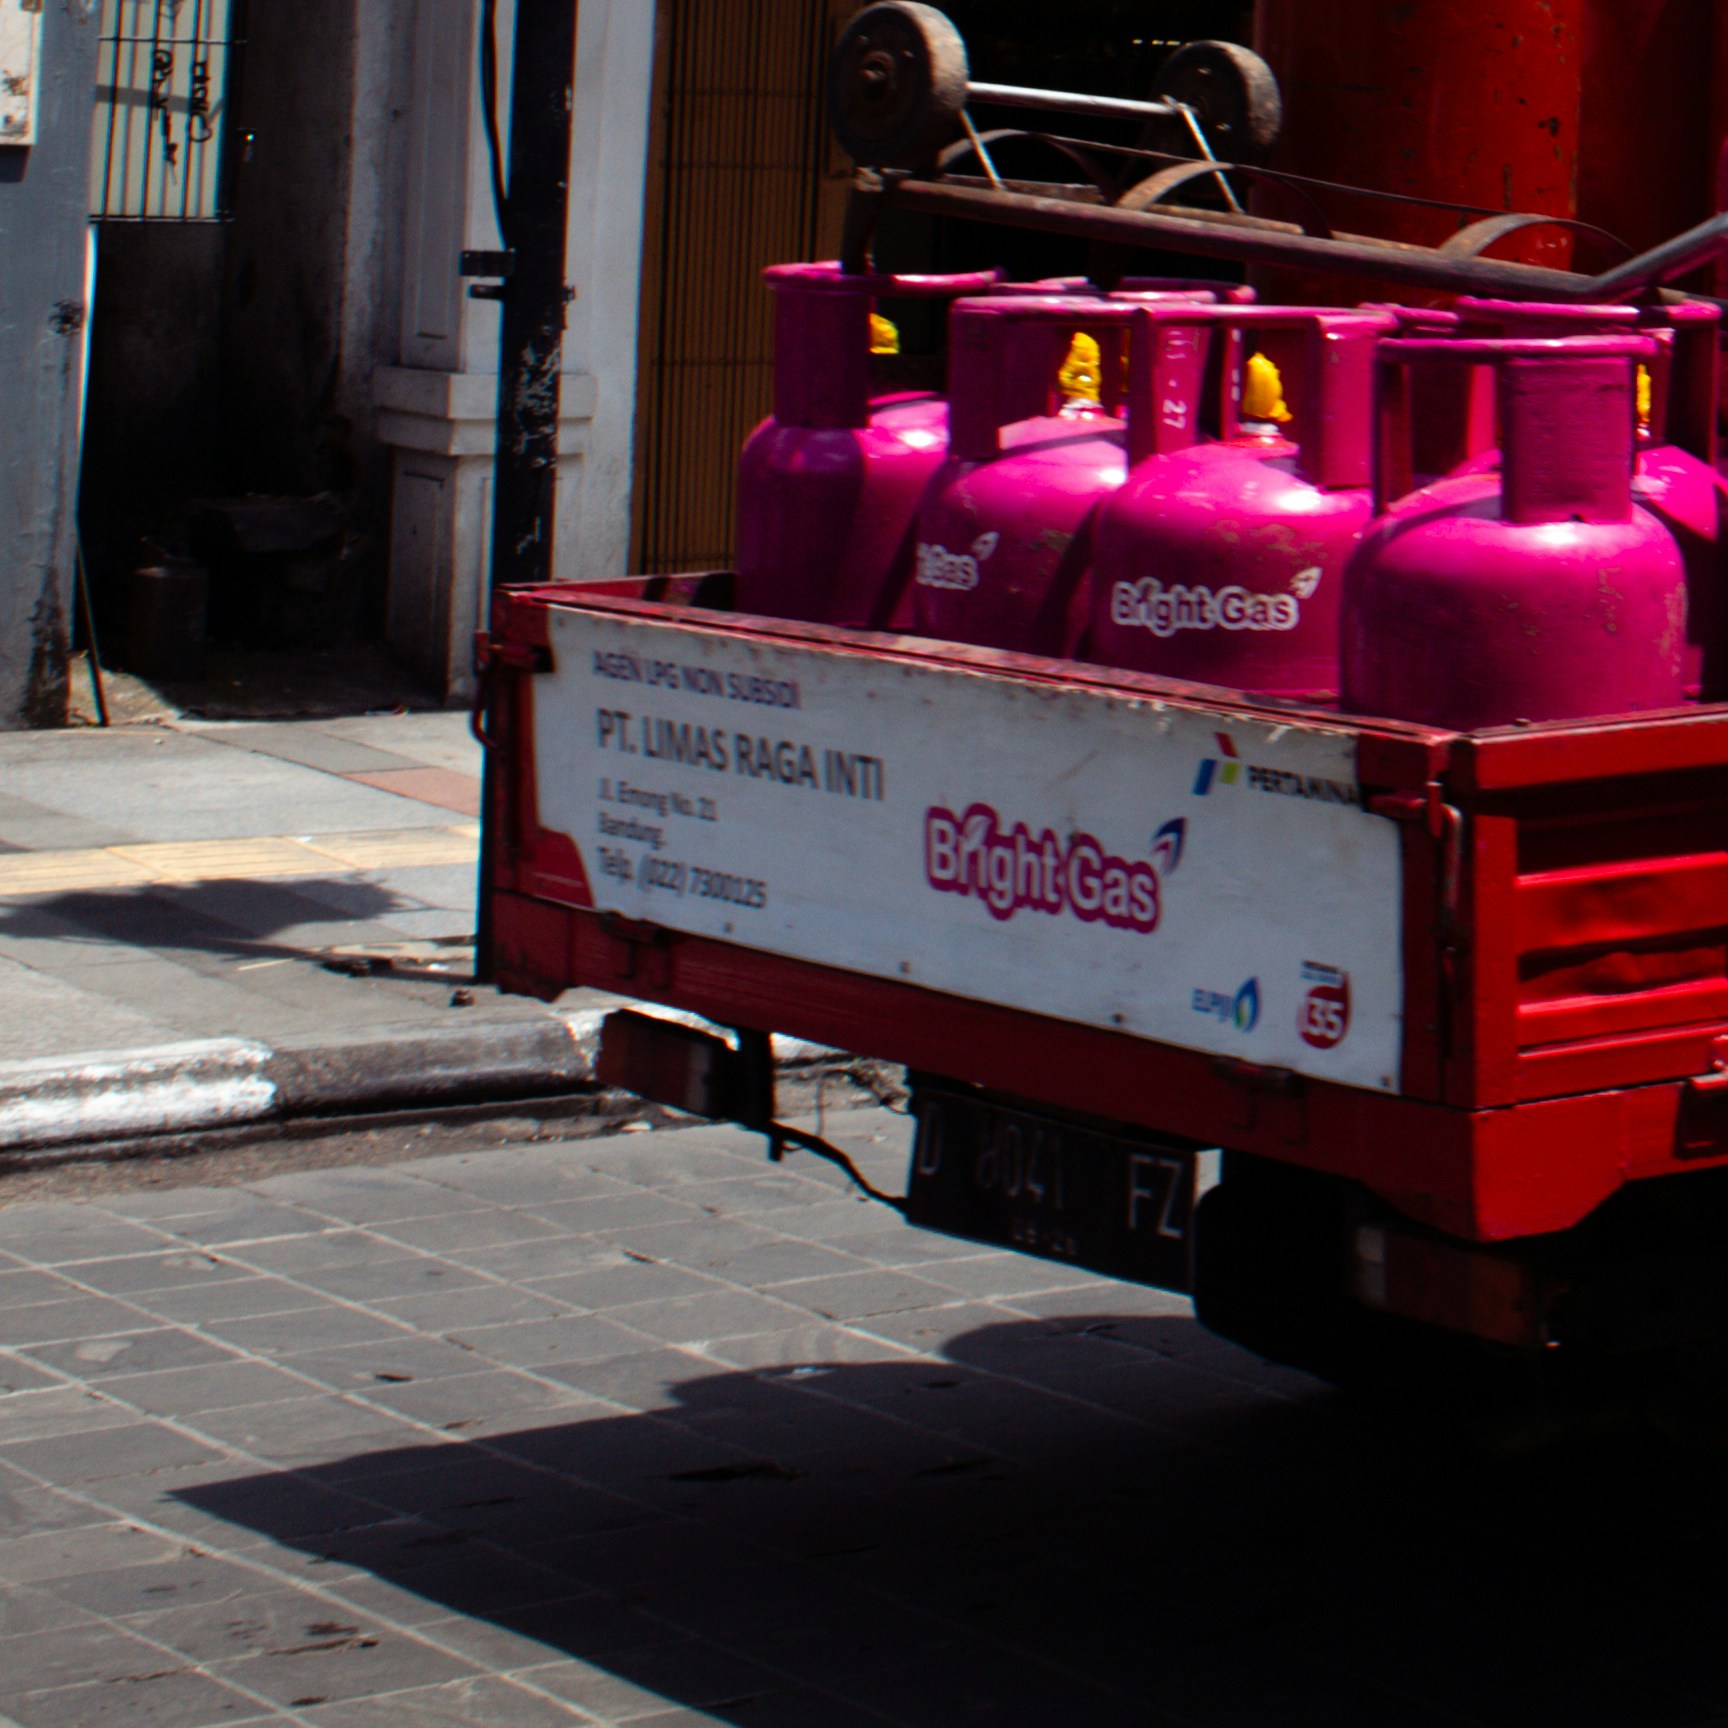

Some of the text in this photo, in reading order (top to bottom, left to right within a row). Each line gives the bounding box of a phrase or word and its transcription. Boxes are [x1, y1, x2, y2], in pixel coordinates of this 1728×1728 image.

[1111, 577, 1300, 638] Bright Gas
[592, 649, 802, 710] AGEN LPG NON SUBSIDI
[597, 708, 886, 801] PT. LIMAS RAGA INTI
[637, 855, 685, 898] (022)
[687, 865, 768, 910] 7300125
[925, 804, 1162, 934] Bright Gas
[1127, 1152, 1185, 1241] FZ
